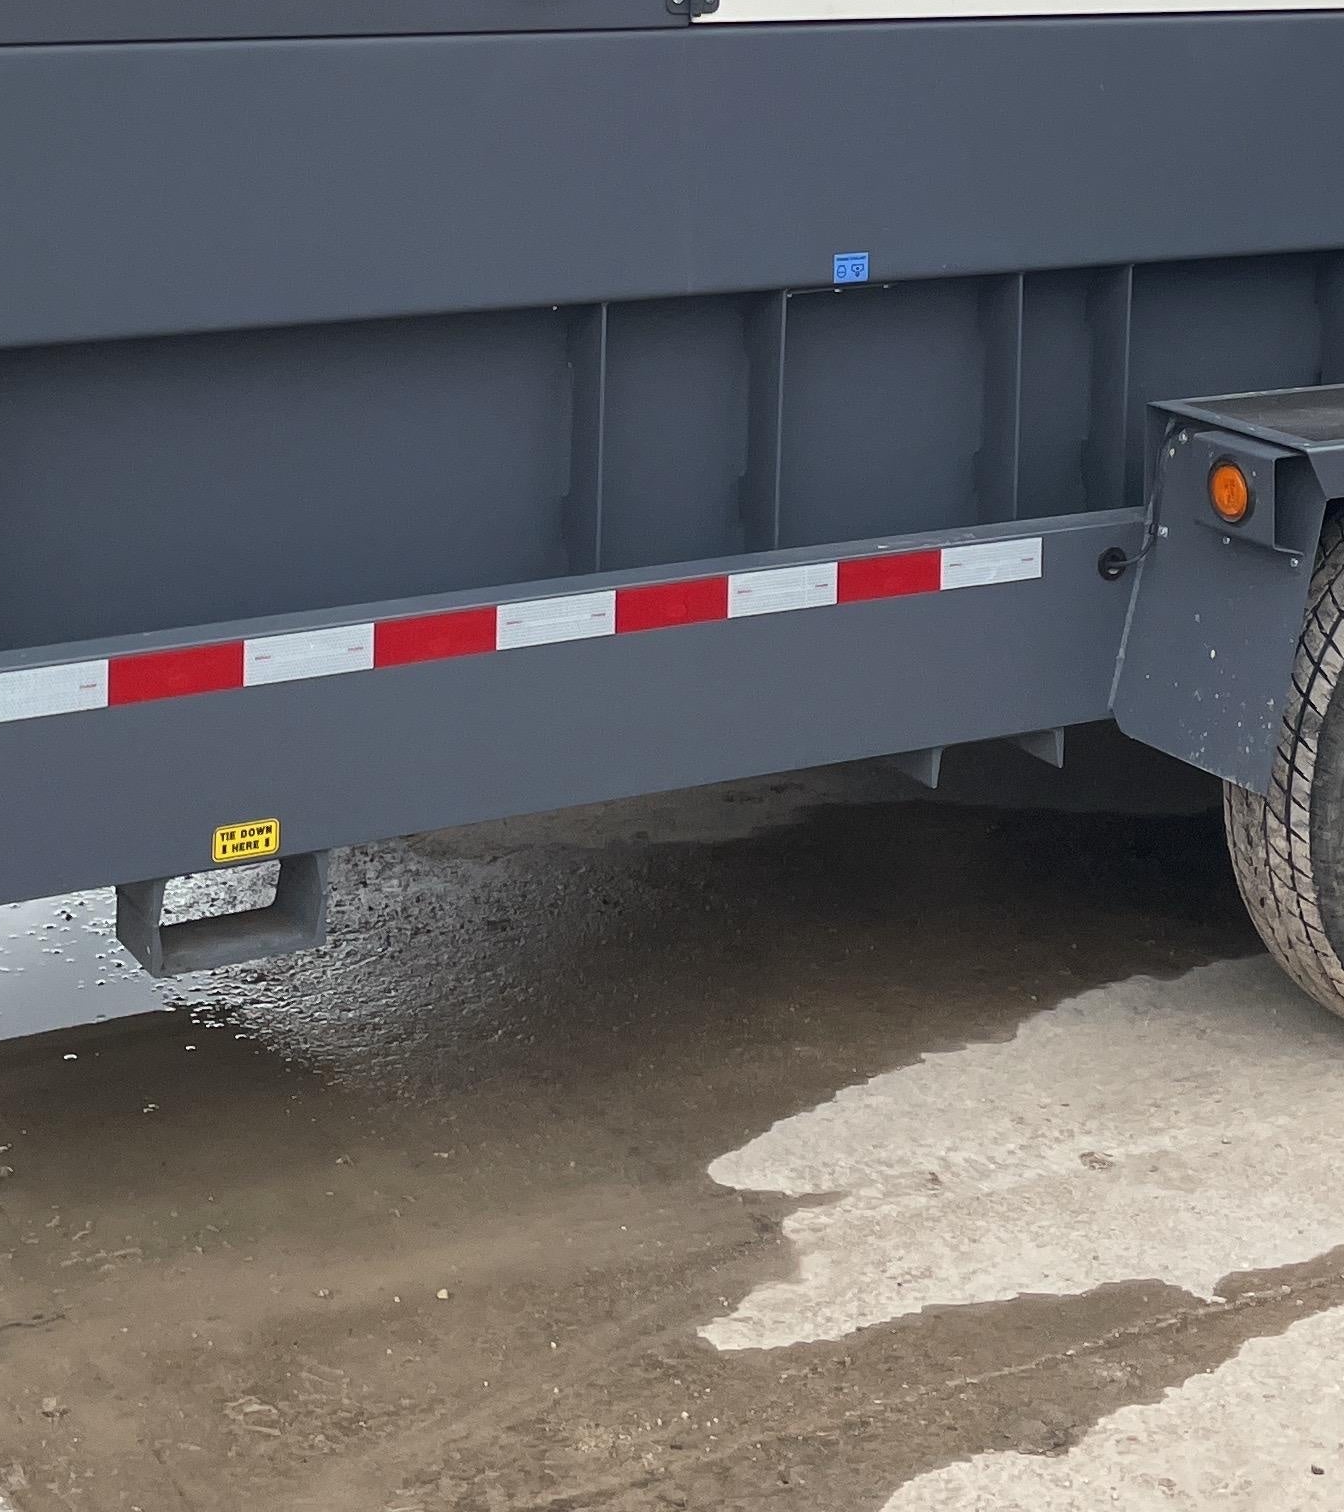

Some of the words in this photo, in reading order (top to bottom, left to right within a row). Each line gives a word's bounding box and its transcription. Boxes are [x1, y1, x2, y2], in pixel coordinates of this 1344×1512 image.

[220, 830, 236, 842] TIE
[240, 824, 273, 839] DOWN
[232, 839, 260, 853] HERE
